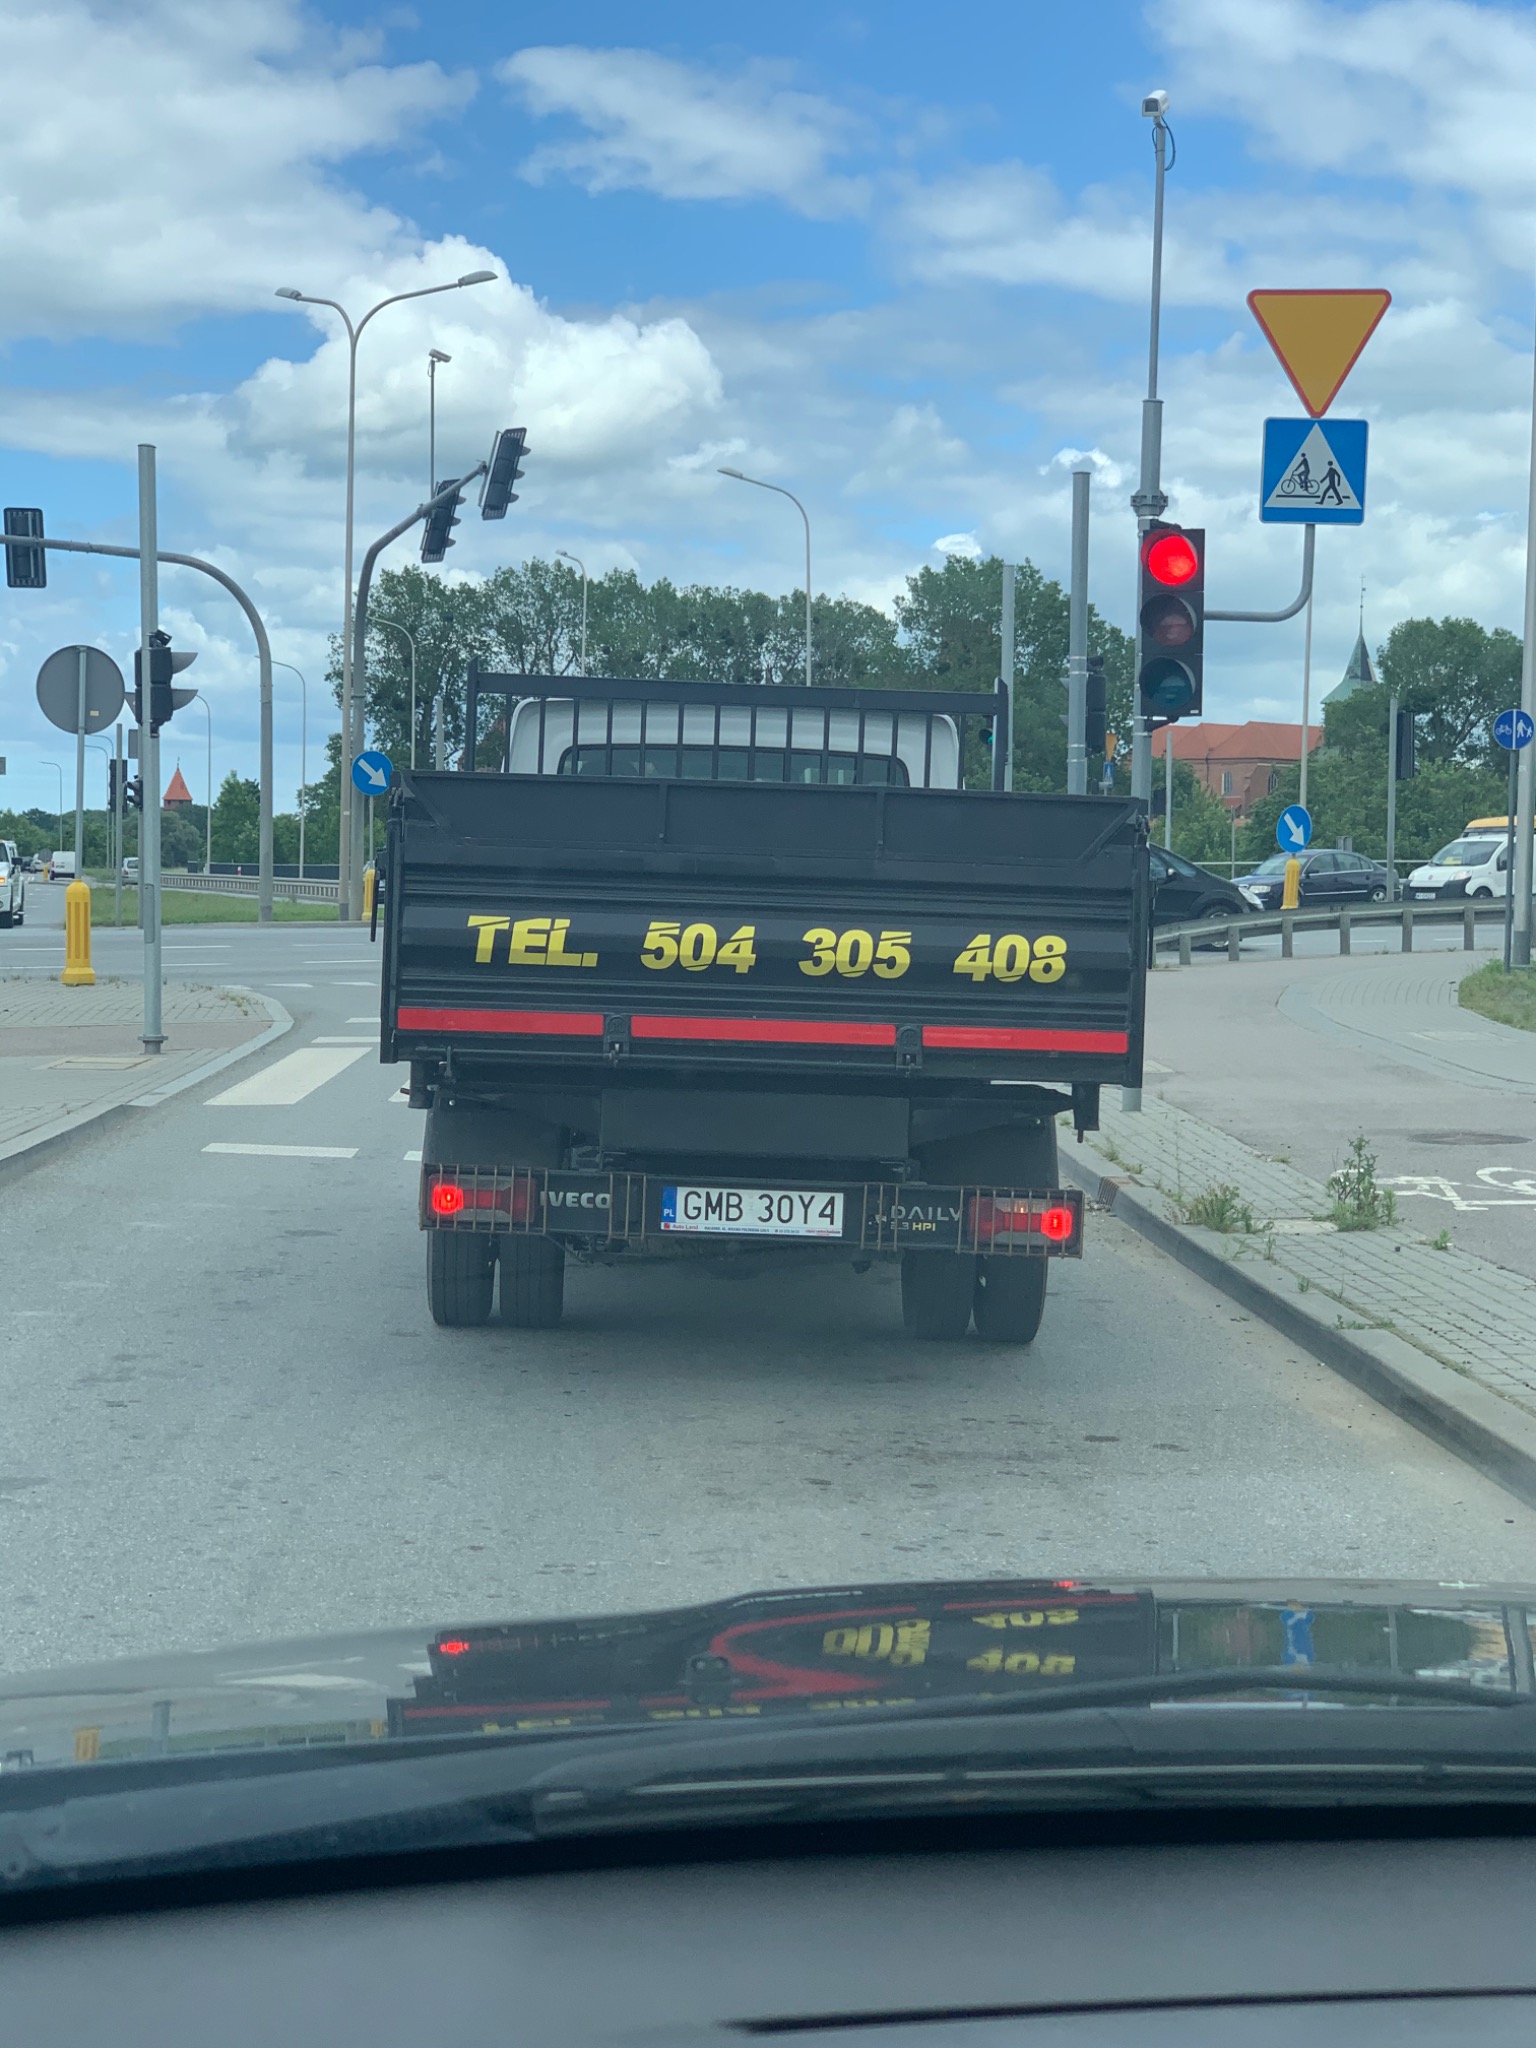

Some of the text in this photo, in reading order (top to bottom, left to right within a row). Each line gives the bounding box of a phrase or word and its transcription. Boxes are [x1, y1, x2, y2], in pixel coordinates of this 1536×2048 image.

[467, 915, 1067, 983] TEL. 504 305 408
[540, 1191, 612, 1209] IVECO
[683, 1191, 836, 1226] GMB 30Y4
[663, 1208, 675, 1217] PL
[890, 1205, 962, 1222] DAILY
[912, 1222, 936, 1231] HPI
